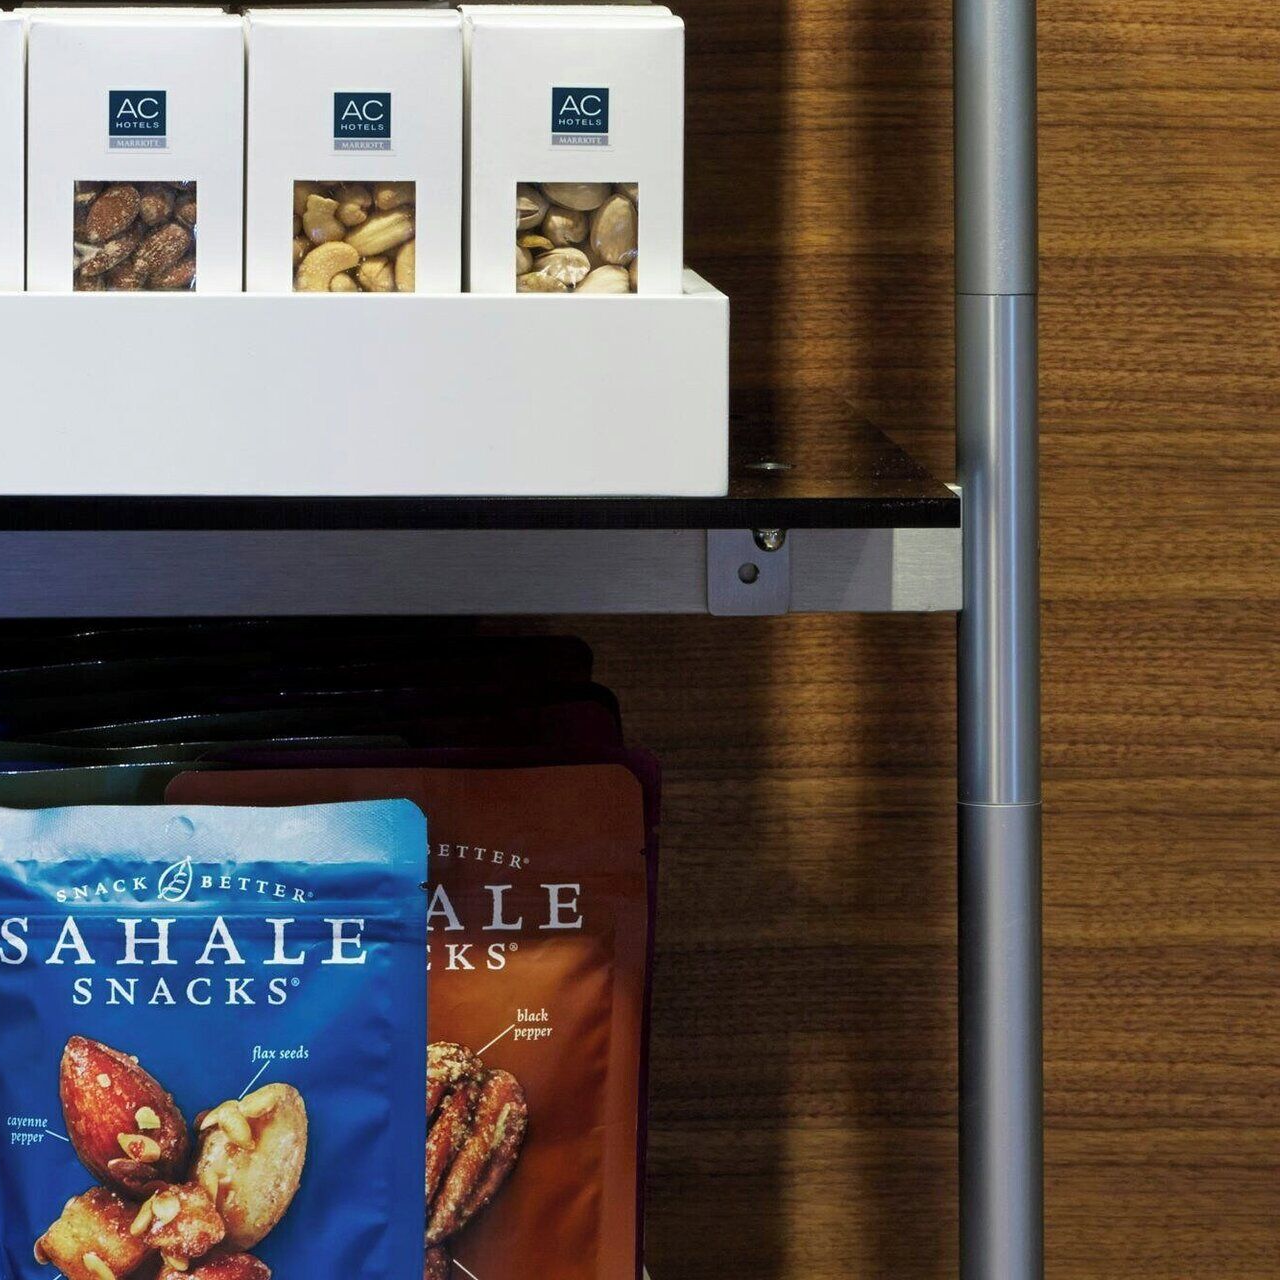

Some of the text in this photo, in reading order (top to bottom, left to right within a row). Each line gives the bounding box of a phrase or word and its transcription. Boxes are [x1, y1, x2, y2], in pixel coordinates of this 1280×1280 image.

[116, 97, 159, 119] AC
[341, 99, 384, 121] AC
[559, 94, 602, 116] AC
[115, 121, 160, 129] HOTELS
[340, 123, 385, 131] HOTELS
[558, 118, 602, 126] HOTELS
[56, 876, 148, 903] SNACK
[0, 915, 368, 965] SAHALE
[516, 1008, 549, 1022] black
[514, 1026, 553, 1040] pepper
[252, 1045, 310, 1062] flax seeds
[7, 1114, 48, 1130] cayenne
[11, 1130, 45, 1144] pepper
